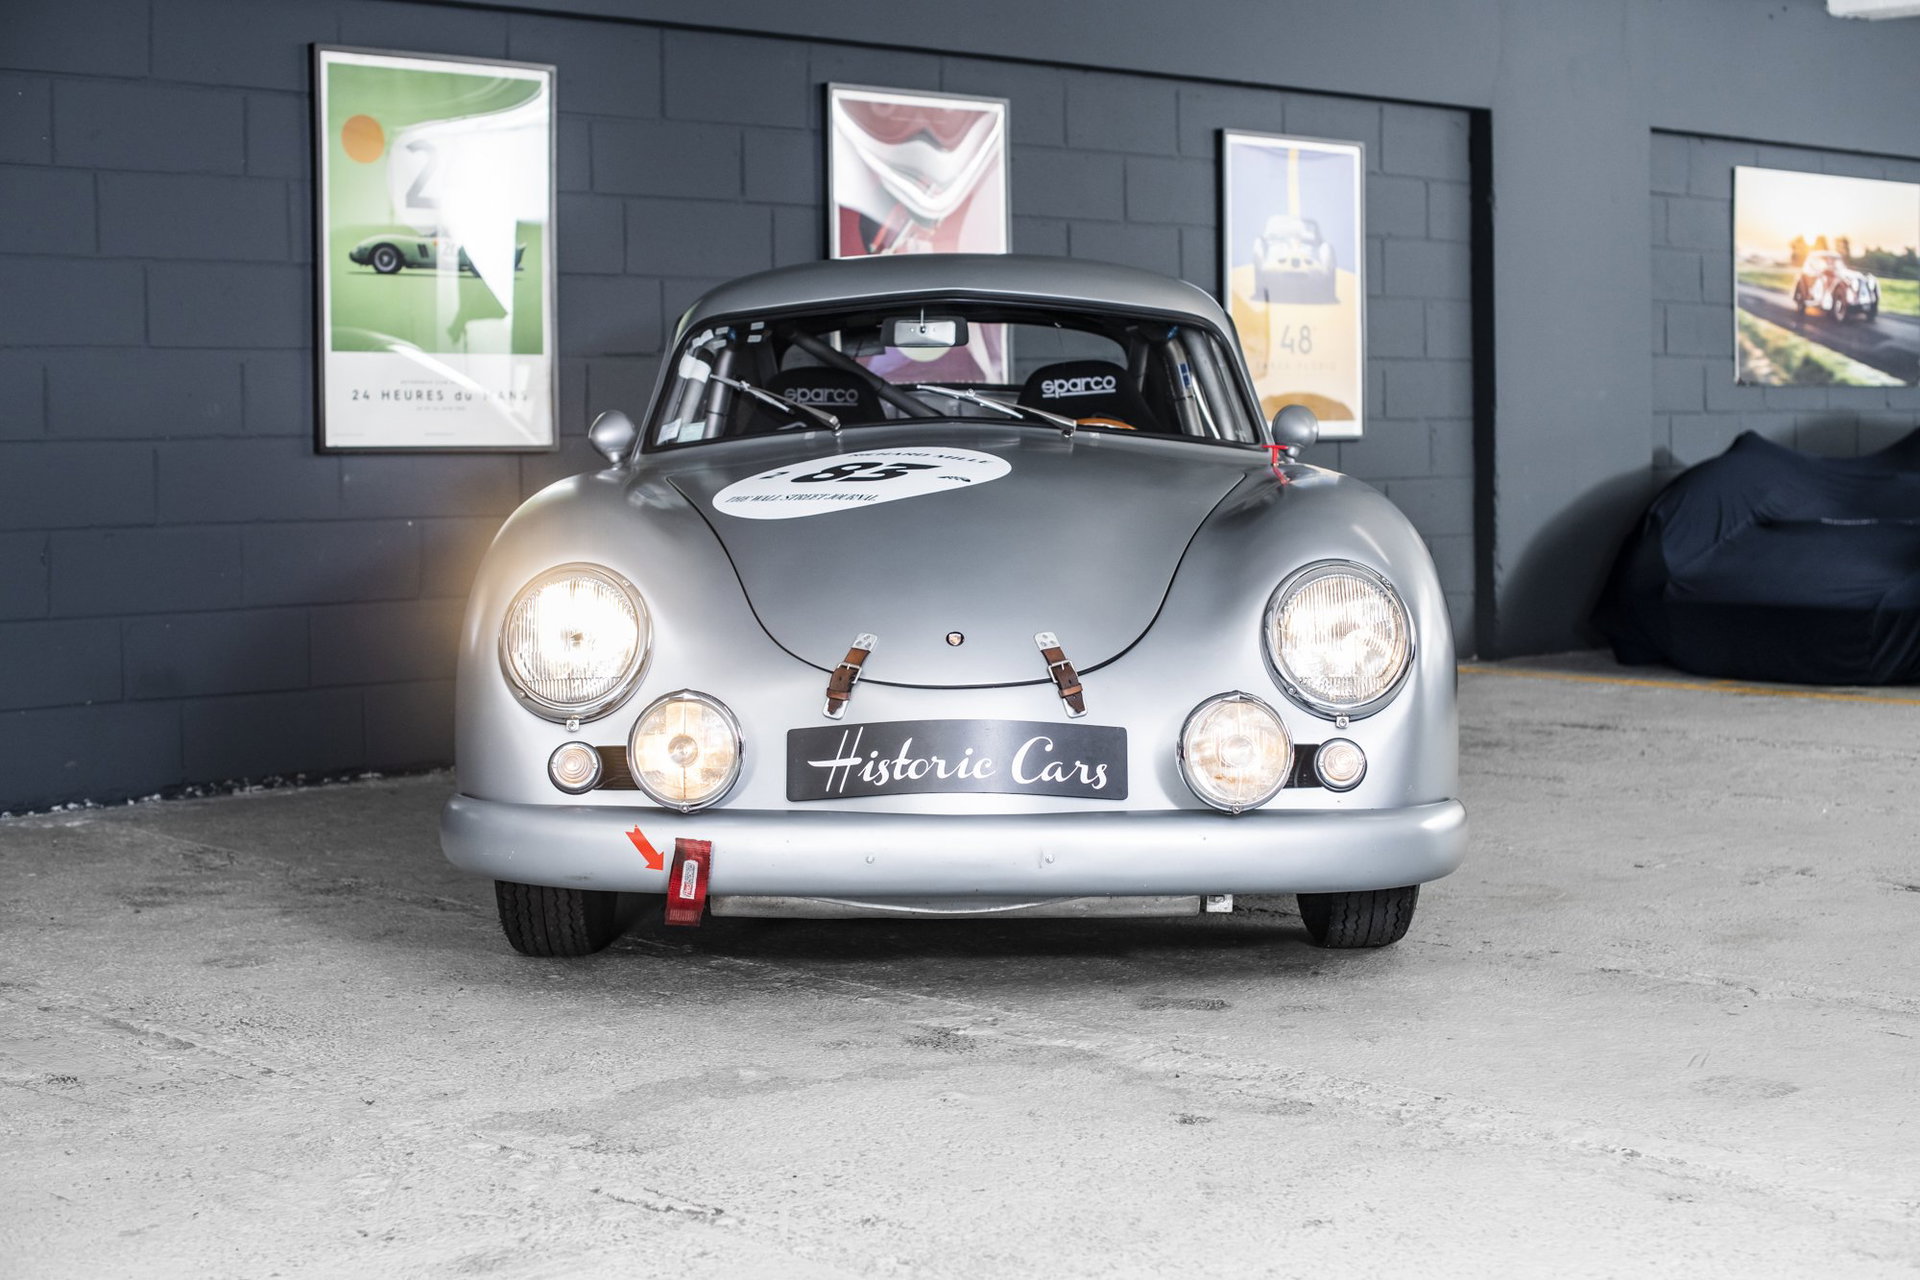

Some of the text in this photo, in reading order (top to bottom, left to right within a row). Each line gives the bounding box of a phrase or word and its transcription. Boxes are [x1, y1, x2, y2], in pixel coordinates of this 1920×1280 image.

[1280, 324, 1313, 355] 48
[352, 389, 370, 401] 24
[381, 389, 444, 401] HEURES
[454, 389, 472, 401] du
[784, 387, 859, 406] sparco
[1041, 375, 1116, 399] sparco
[807, 726, 1108, 794] Historic Cars
